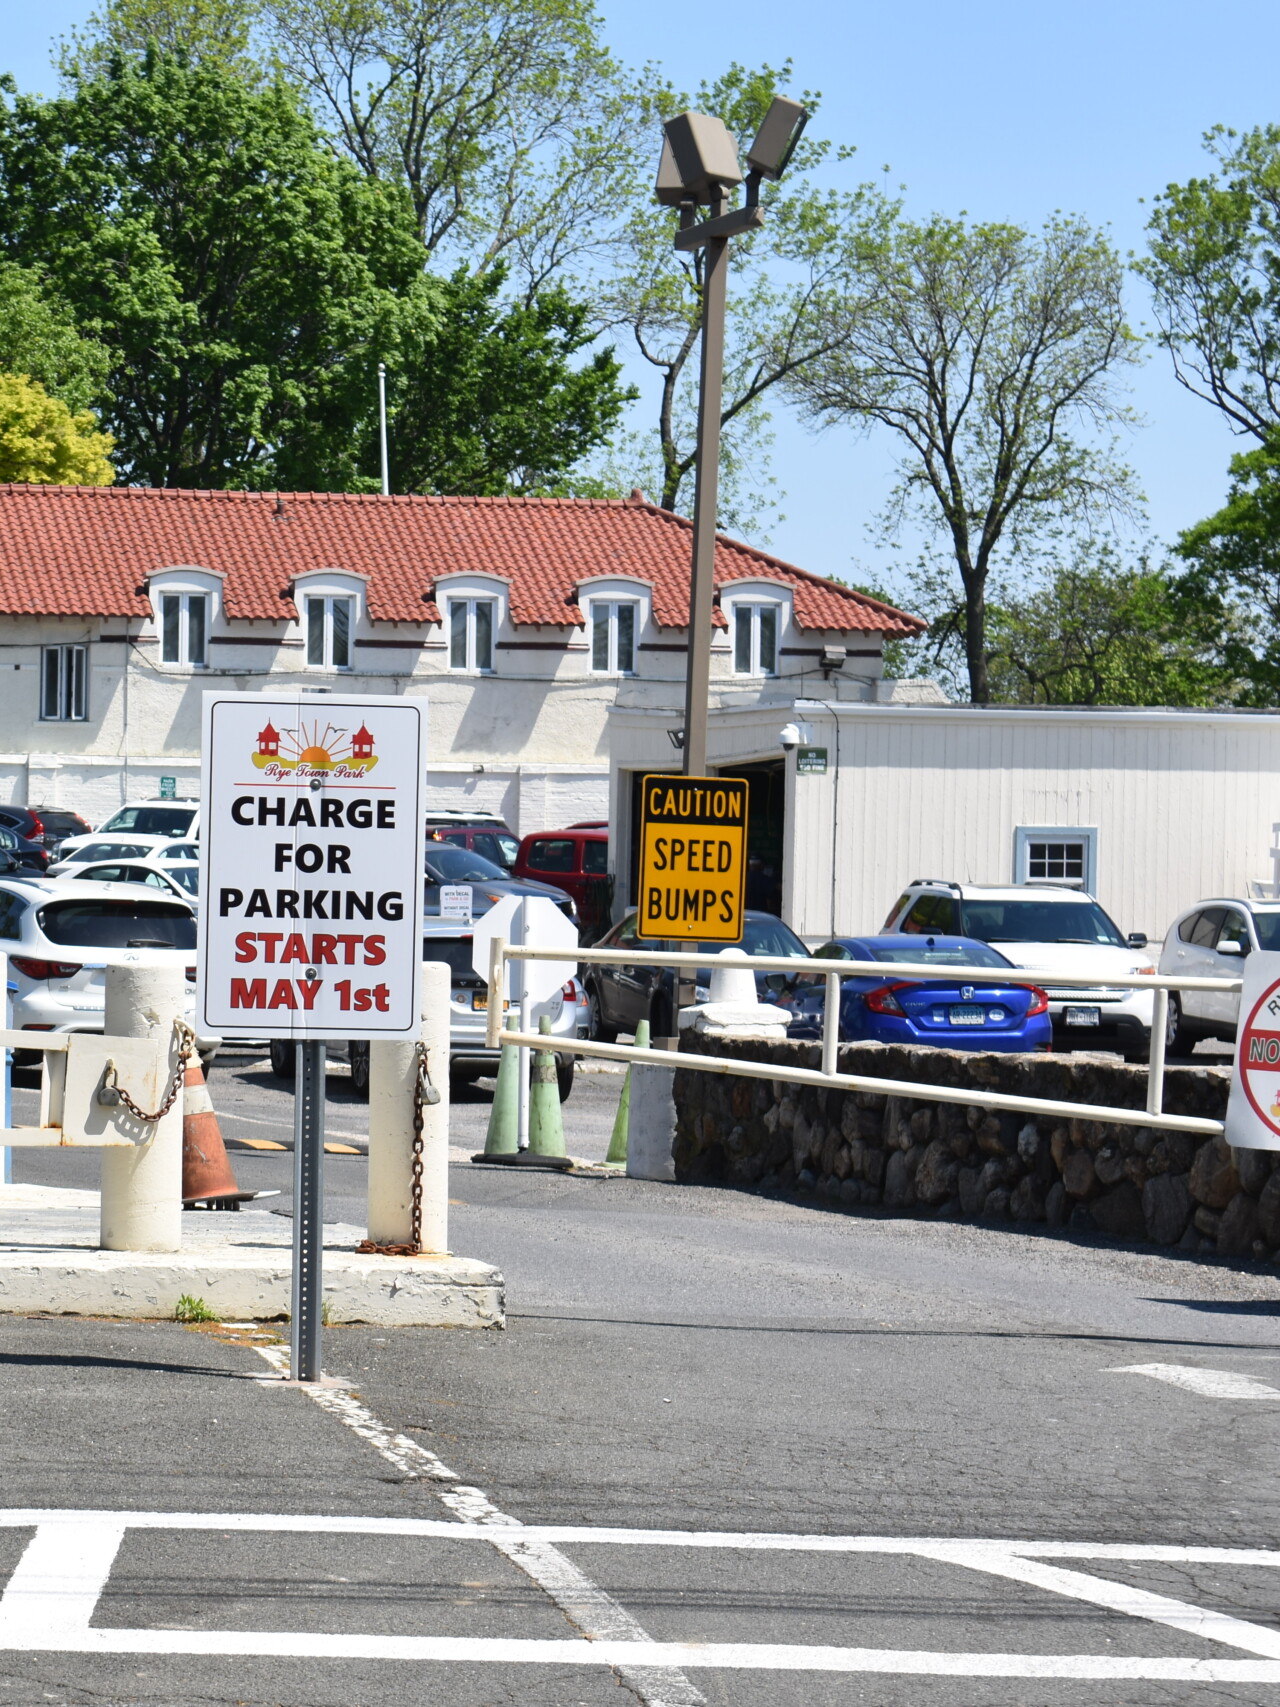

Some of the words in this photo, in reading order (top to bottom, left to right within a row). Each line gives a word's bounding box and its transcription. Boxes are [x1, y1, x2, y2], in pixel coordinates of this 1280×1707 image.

[265, 763, 292, 782] Rye
[295, 764, 330, 778] Town
[333, 765, 365, 779] Park
[231, 796, 396, 829] CHARGE
[650, 788, 741, 818] CAUTION
[274, 843, 351, 874] FOR
[653, 838, 732, 873] SPEED
[220, 888, 404, 921] PARKING
[648, 887, 734, 923] BUMPS
[235, 932, 387, 966] STARTS
[230, 978, 323, 1010] MAY
[334, 979, 390, 1012] 1st
